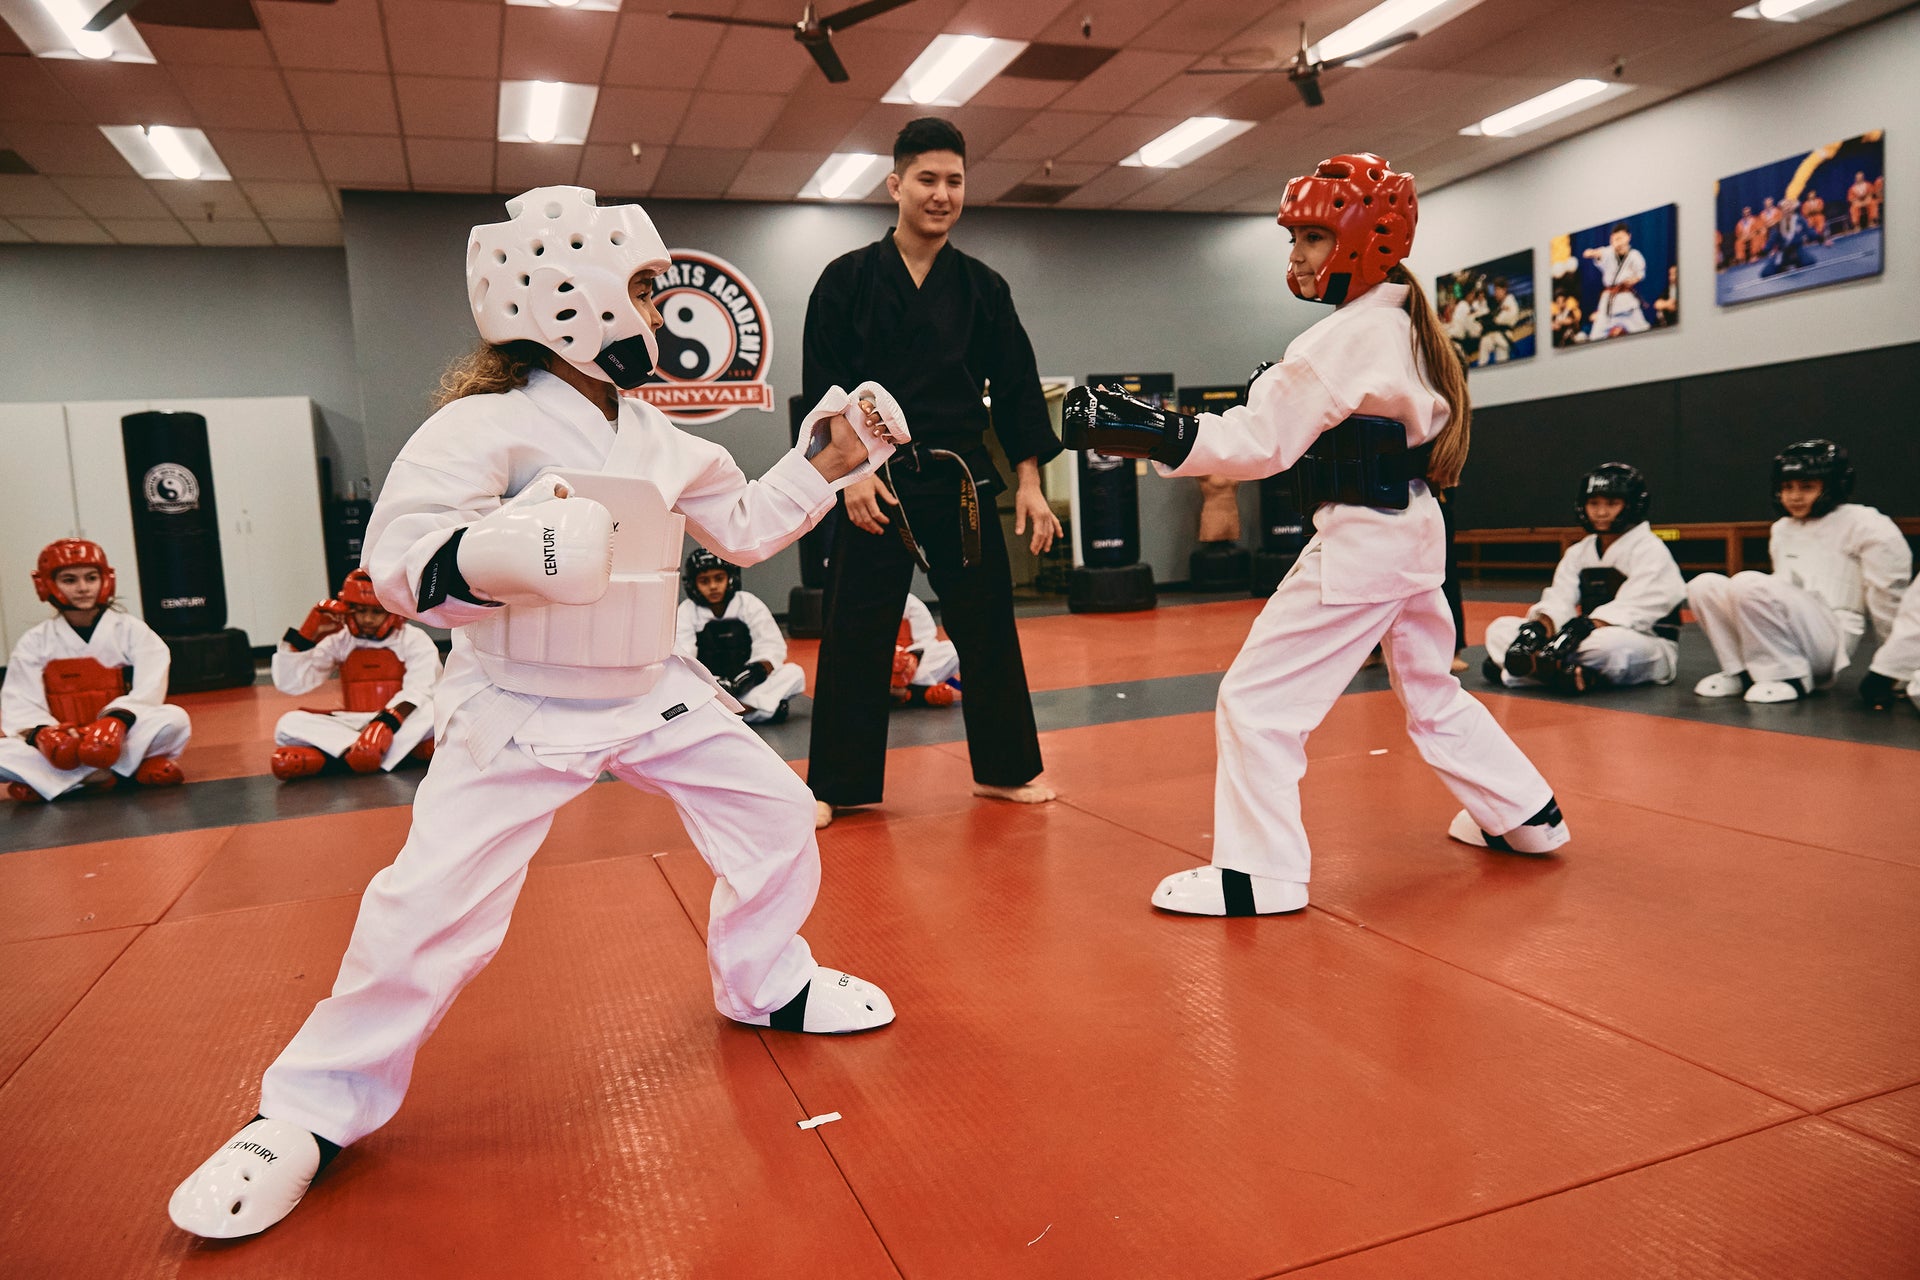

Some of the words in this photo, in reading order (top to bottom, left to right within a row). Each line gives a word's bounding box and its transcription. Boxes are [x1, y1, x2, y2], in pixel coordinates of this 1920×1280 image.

[655, 264, 706, 290] ARTS
[709, 274, 761, 366] ACADEMY
[543, 527, 558, 576] CENTURY
